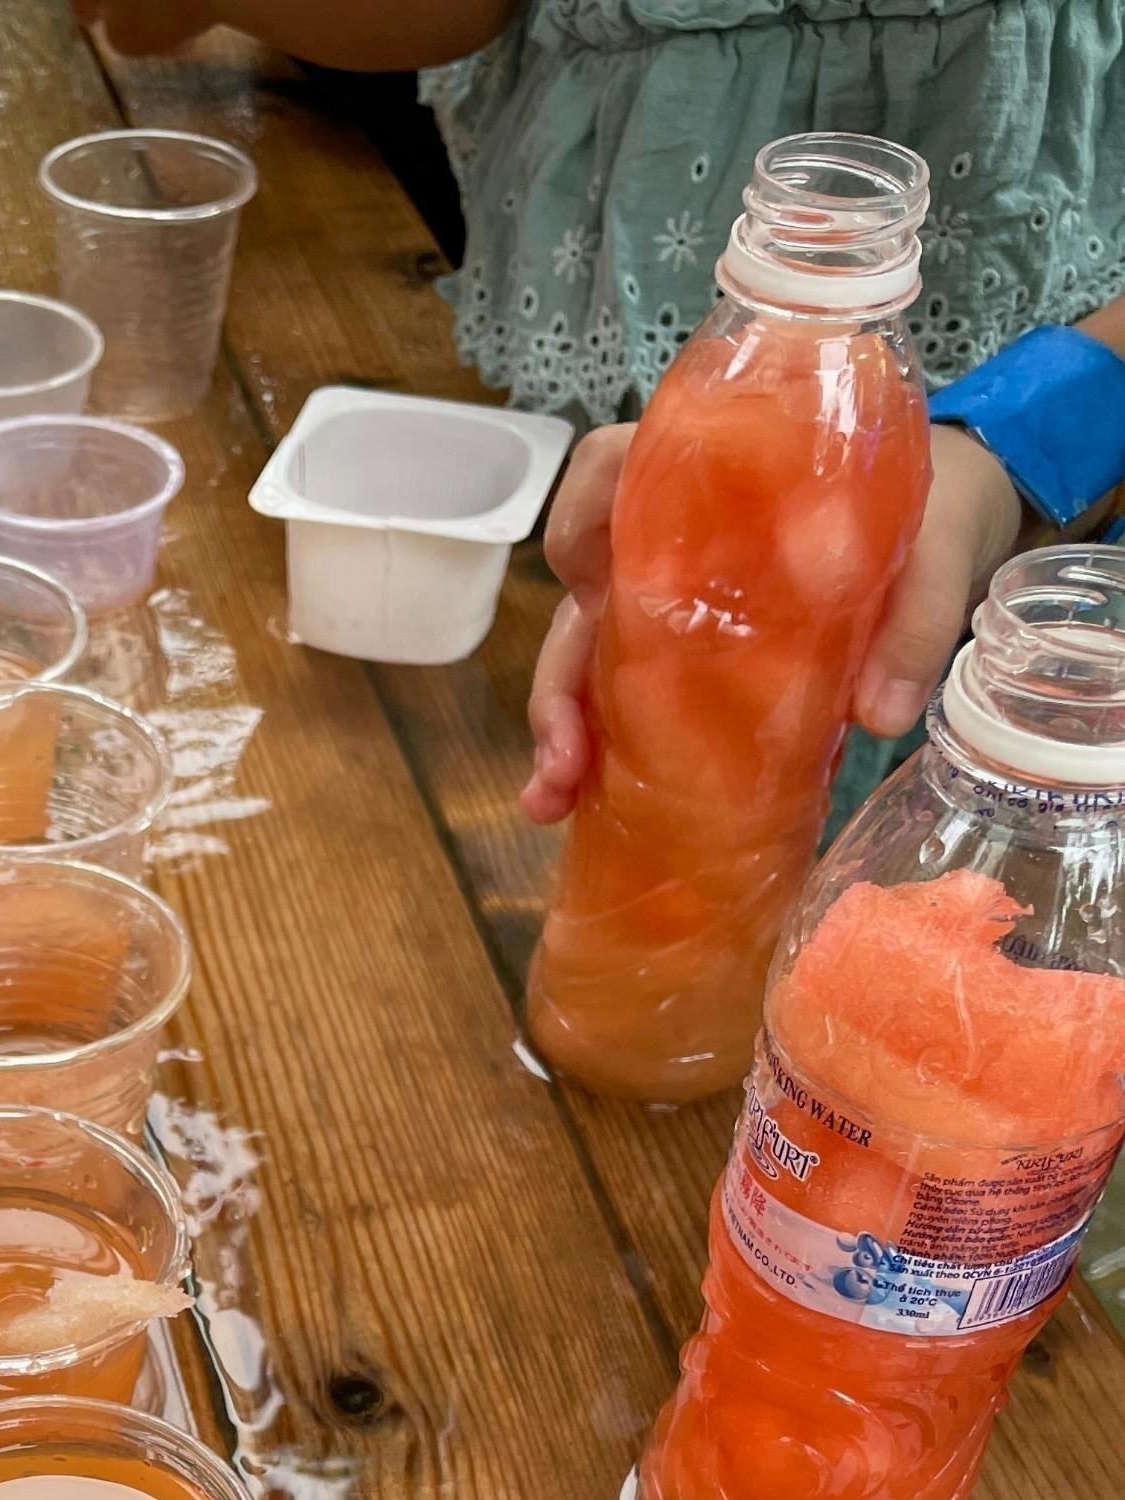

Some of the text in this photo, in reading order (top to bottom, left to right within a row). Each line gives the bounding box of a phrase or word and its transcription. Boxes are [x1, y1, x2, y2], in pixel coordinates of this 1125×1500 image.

[809, 1098, 873, 1148] WATER
[913, 1259, 936, 1270] tiêu
[936, 1261, 962, 1272] chất
[909, 1267, 934, 1279] xuất
[935, 1269, 961, 1280] theo
[962, 1268, 993, 1281] QCVN
[934, 1288, 962, 1298] thực
[895, 1307, 931, 1319] 330ml
